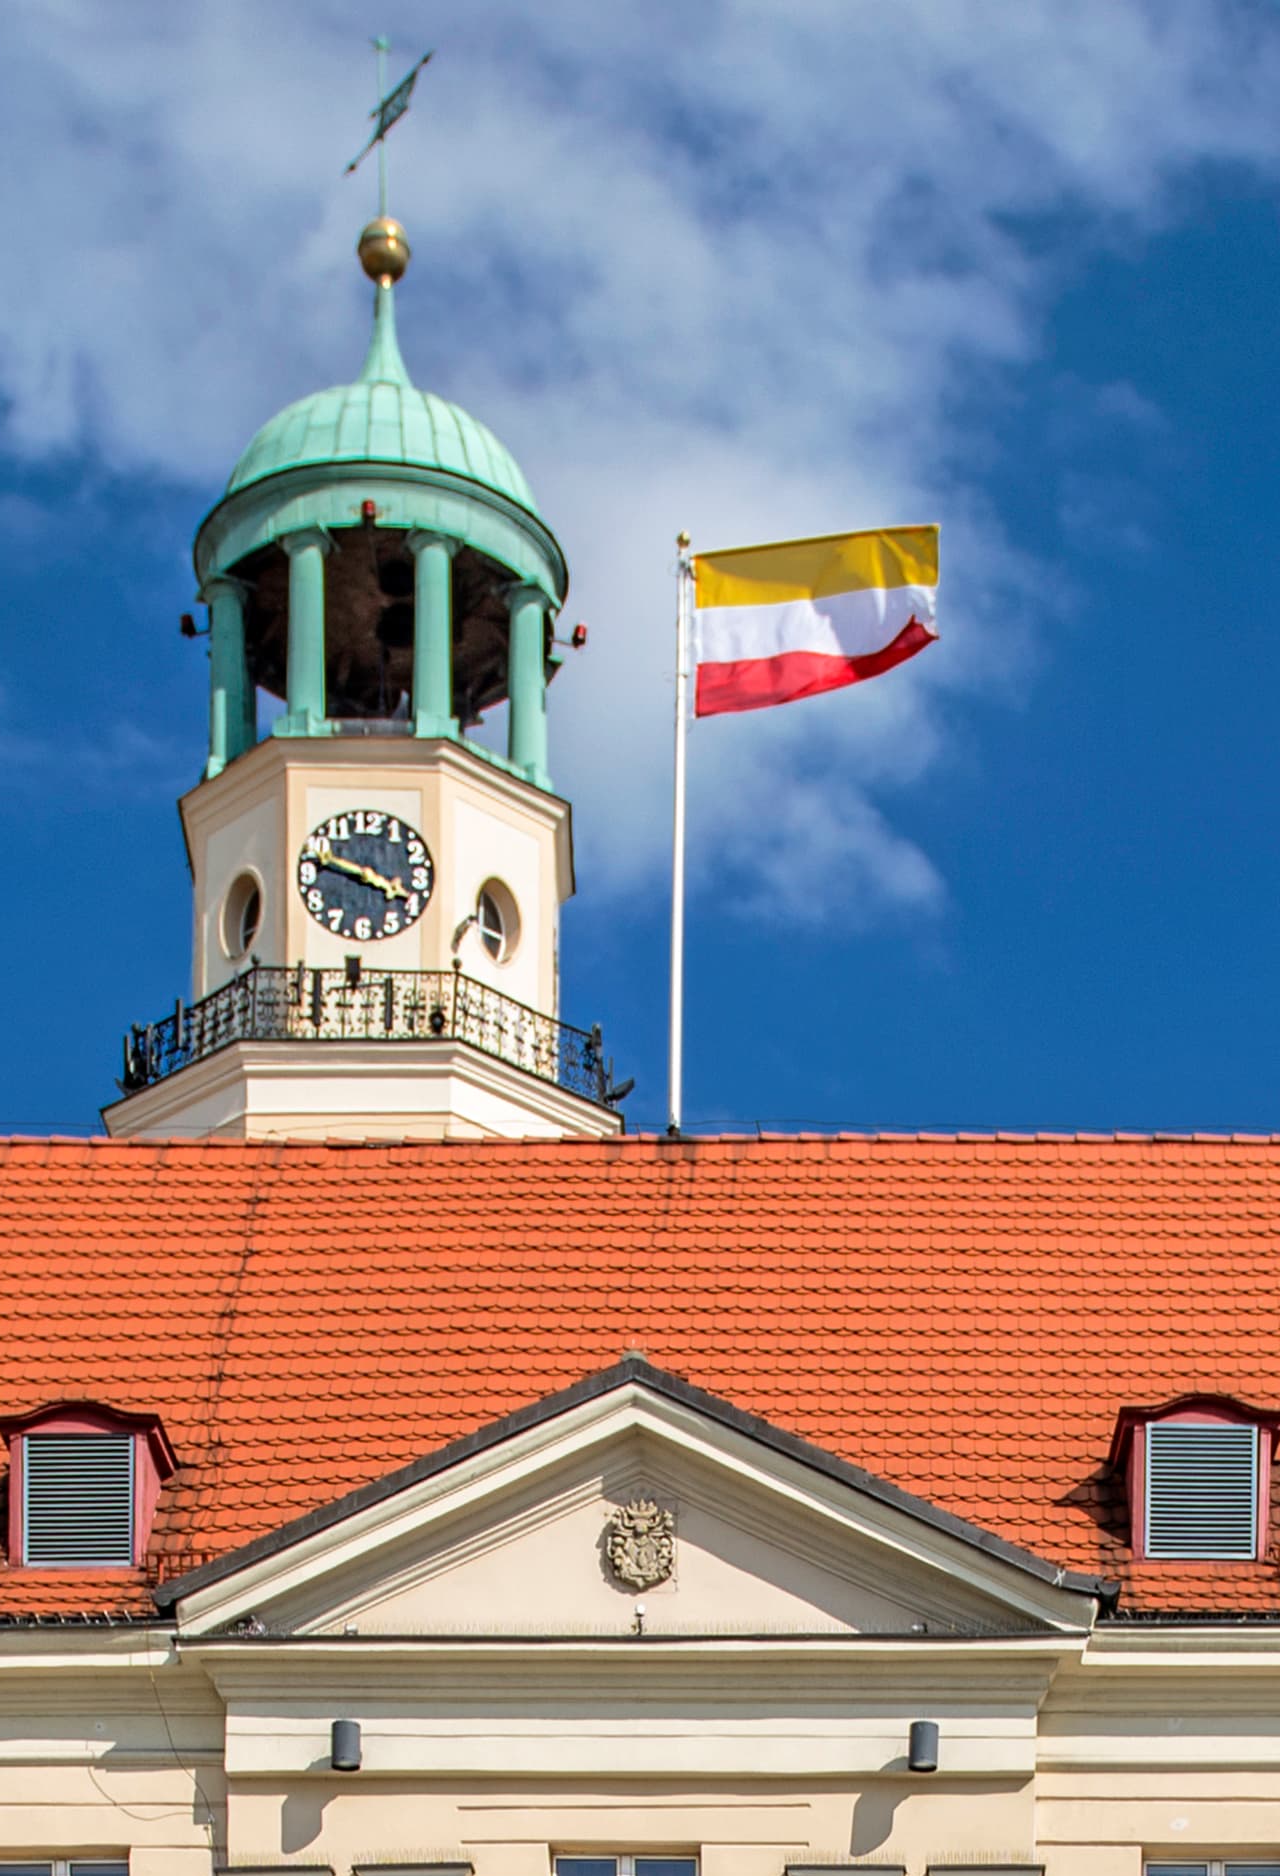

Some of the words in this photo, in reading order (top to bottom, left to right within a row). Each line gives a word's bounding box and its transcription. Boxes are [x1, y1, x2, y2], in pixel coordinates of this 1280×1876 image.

[326, 817, 350, 840] 11
[354, 812, 383, 835] 12
[388, 819, 402, 842] 1
[307, 836, 331, 858] 10
[407, 840, 425, 864] 2
[299, 861, 317, 885] 9
[411, 867, 429, 889] 3
[306, 889, 324, 911] 8
[327, 908, 344, 931] 7
[354, 917, 371, 940] 6
[383, 912, 400, 934] 5
